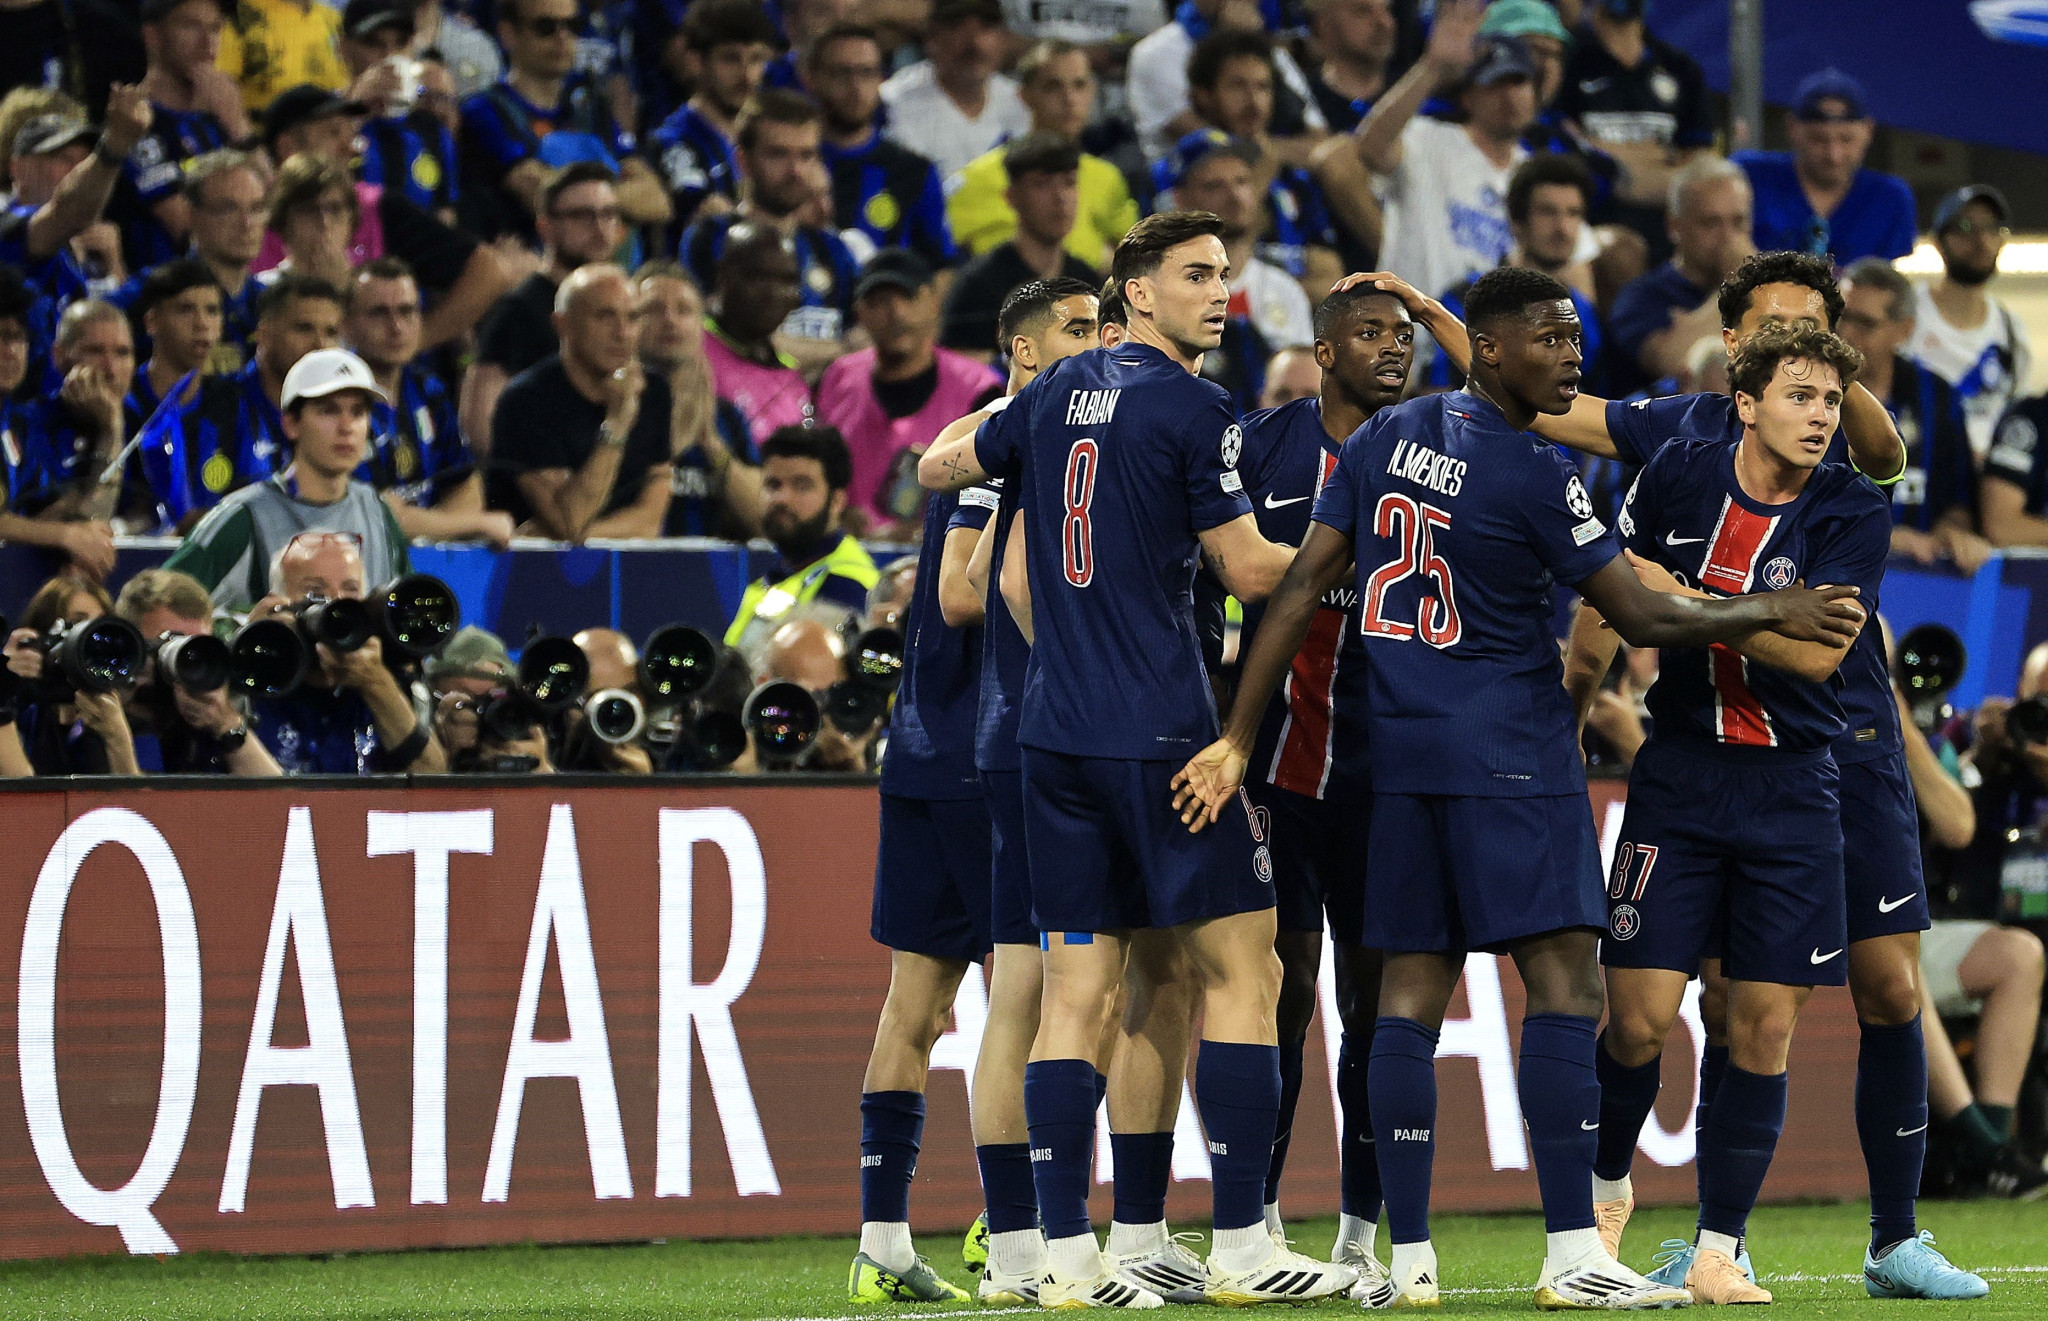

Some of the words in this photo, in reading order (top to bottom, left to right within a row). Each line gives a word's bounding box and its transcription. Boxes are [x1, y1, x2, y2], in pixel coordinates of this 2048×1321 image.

[1065, 389, 1121, 425] FABIAN
[1386, 438, 1467, 497] N.MENDES
[1062, 438, 1099, 588] 8
[1361, 492, 1462, 650] 25
[1771, 558, 1793, 569] PARIS
[1611, 841, 1659, 901] 87
[1614, 906, 1634, 916] PARIS
[17, 803, 782, 1257] QATAR
[1208, 1140, 1227, 1155] ARIS
[1394, 1128, 1430, 1142] PARIS
